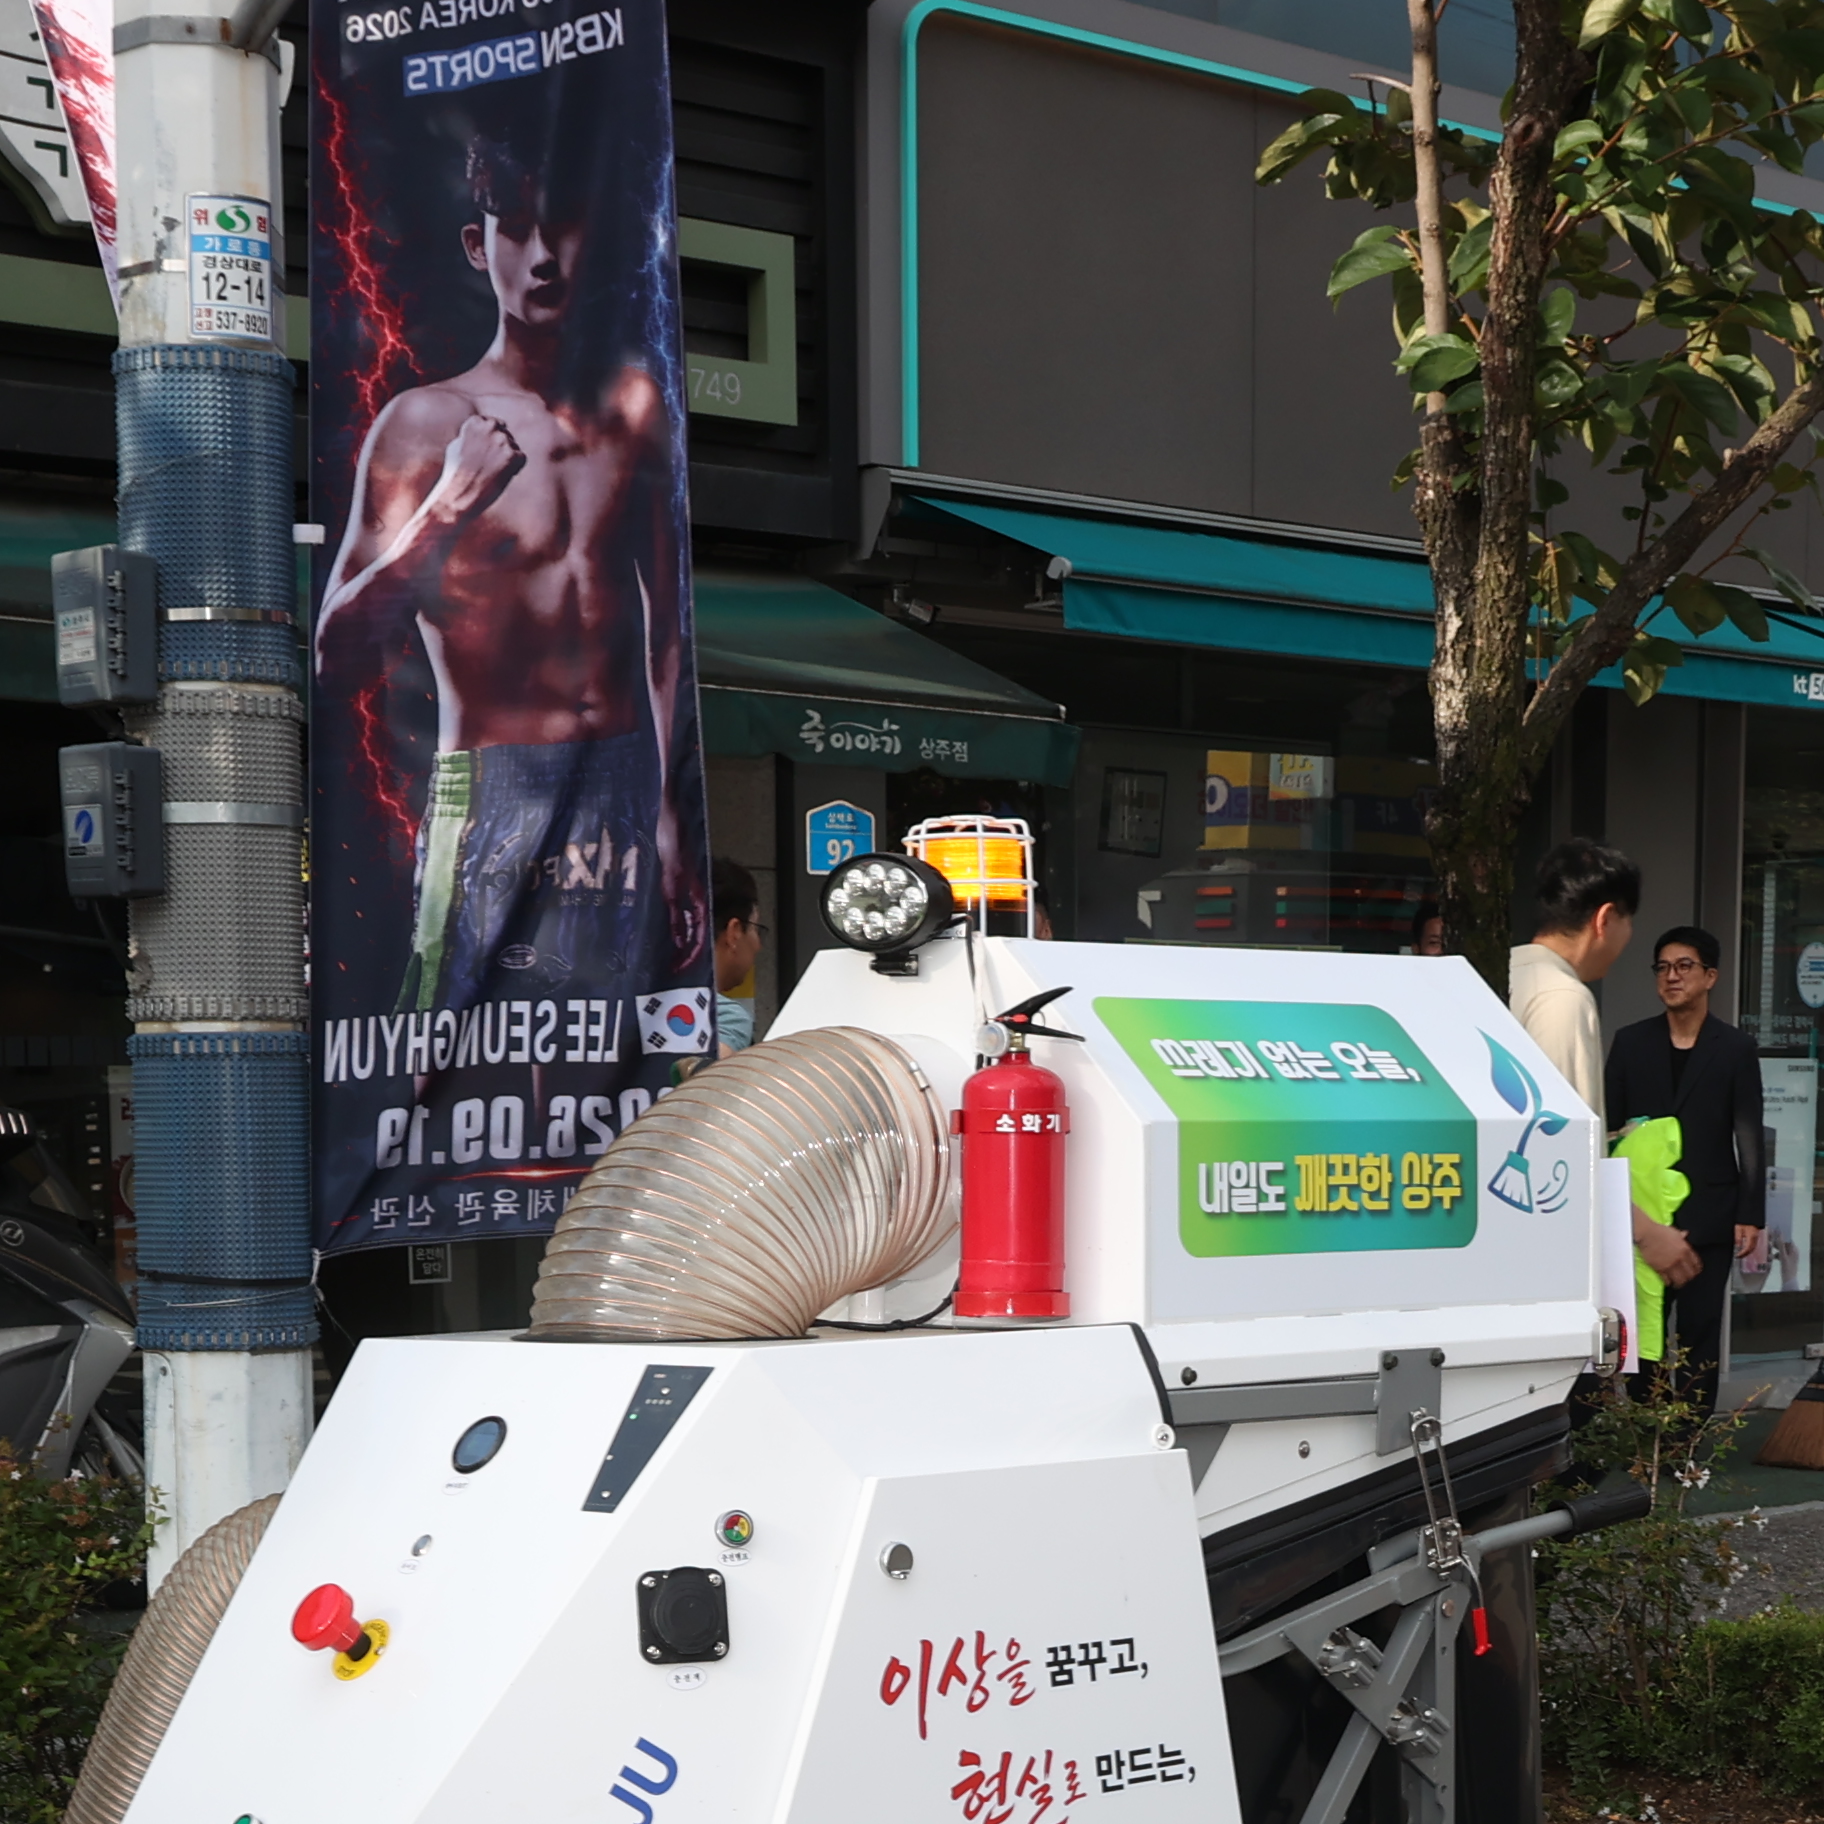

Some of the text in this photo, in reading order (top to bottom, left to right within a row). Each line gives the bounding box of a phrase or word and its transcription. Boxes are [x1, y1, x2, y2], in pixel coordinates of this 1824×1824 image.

[202, 255, 263, 274] 경상대로
[201, 271, 265, 307] 12-14
[216, 310, 269, 336] 537-8920
[799, 709, 969, 763] 죽이야기 상주점
[827, 838, 856, 866] 92
[1150, 1036, 1423, 1086] 쓰레기 없는 오늘,
[995, 1111, 1063, 1135] 소화기
[1197, 1150, 1462, 1217] 내일도 깨끗한 상주
[879, 1629, 1150, 1741] 이상을 꿈꾸고,
[1095, 1742, 1197, 1795] 만드는,
